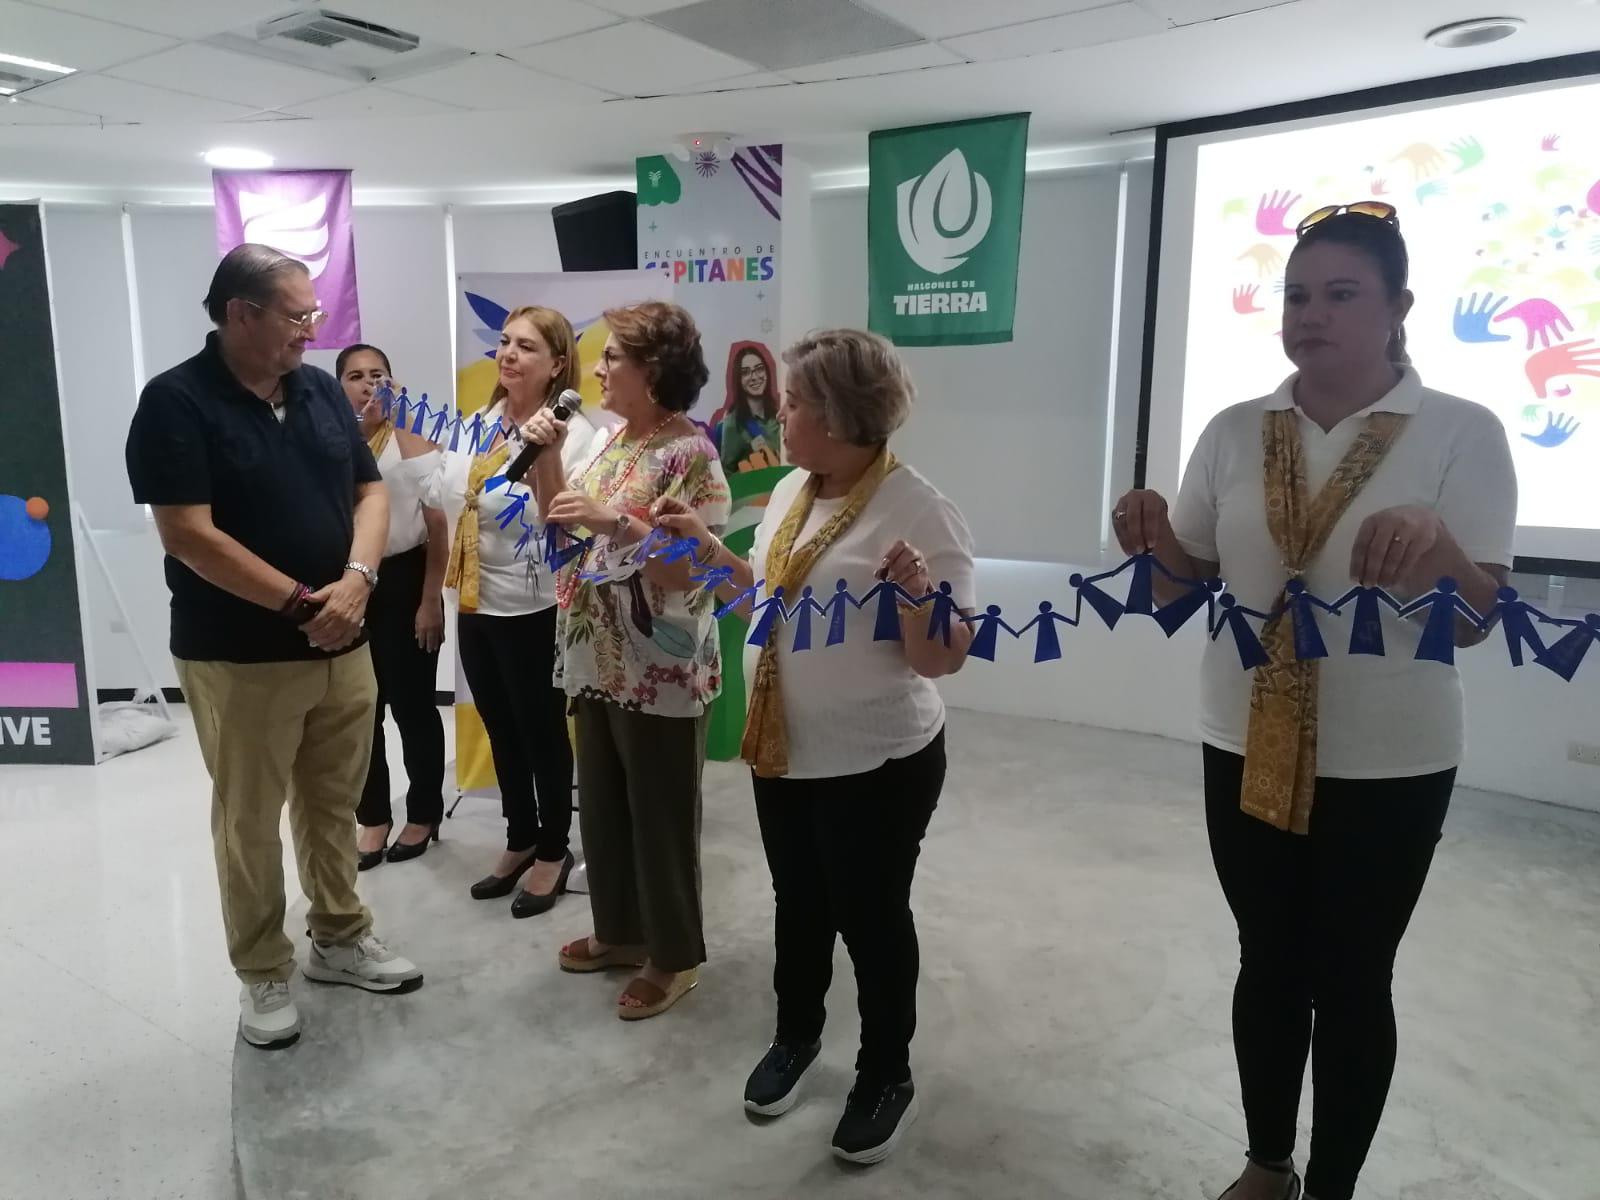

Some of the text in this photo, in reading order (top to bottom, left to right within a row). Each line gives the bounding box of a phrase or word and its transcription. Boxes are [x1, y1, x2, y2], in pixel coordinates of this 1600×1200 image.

[644, 244, 775, 259] ENCUENTRO DE
[961, 280, 976, 288] DE
[893, 291, 988, 316] TIERRA
